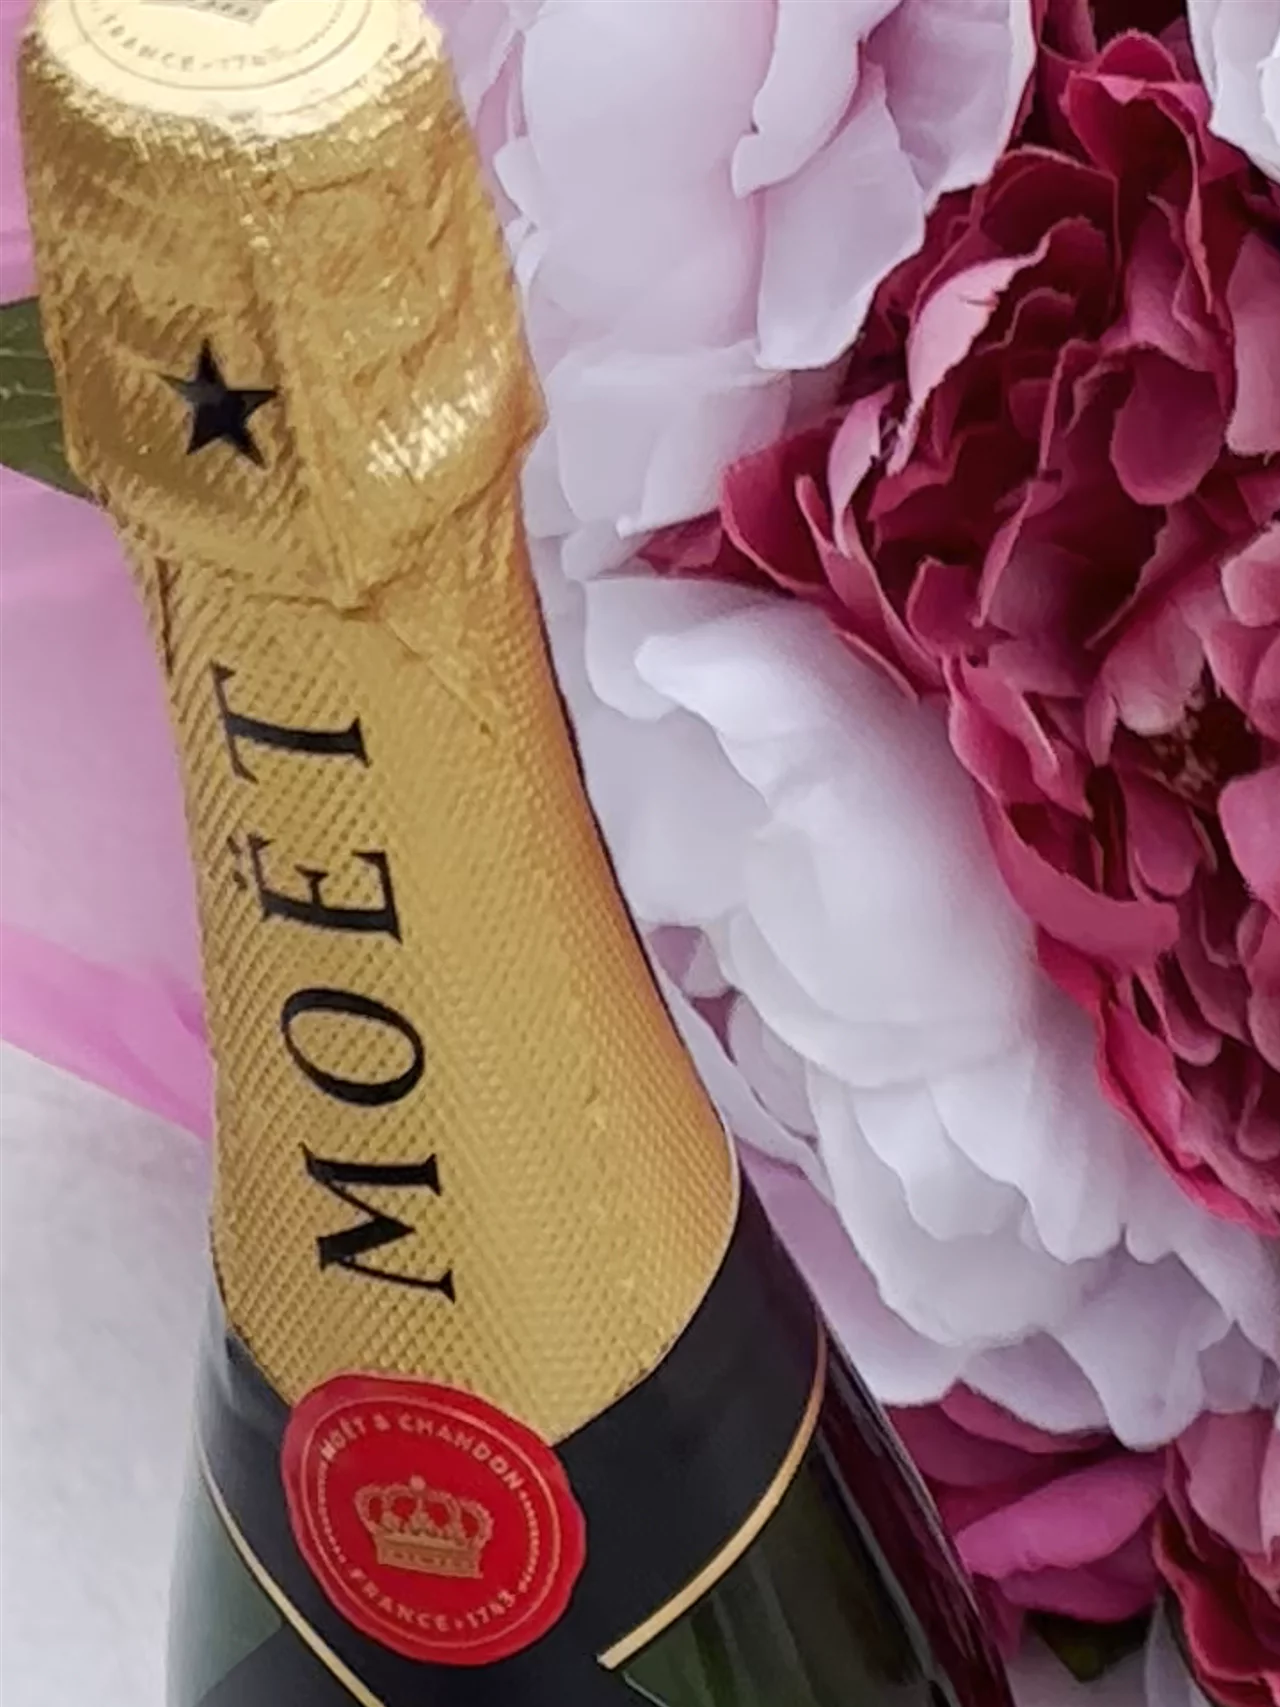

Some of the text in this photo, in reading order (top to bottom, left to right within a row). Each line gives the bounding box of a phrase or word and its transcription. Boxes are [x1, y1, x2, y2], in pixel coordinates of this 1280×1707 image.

[209, 661, 456, 1303] MOËT
[398, 1412, 525, 1490] CHANDON
[351, 1568, 450, 1632] FRANCE
